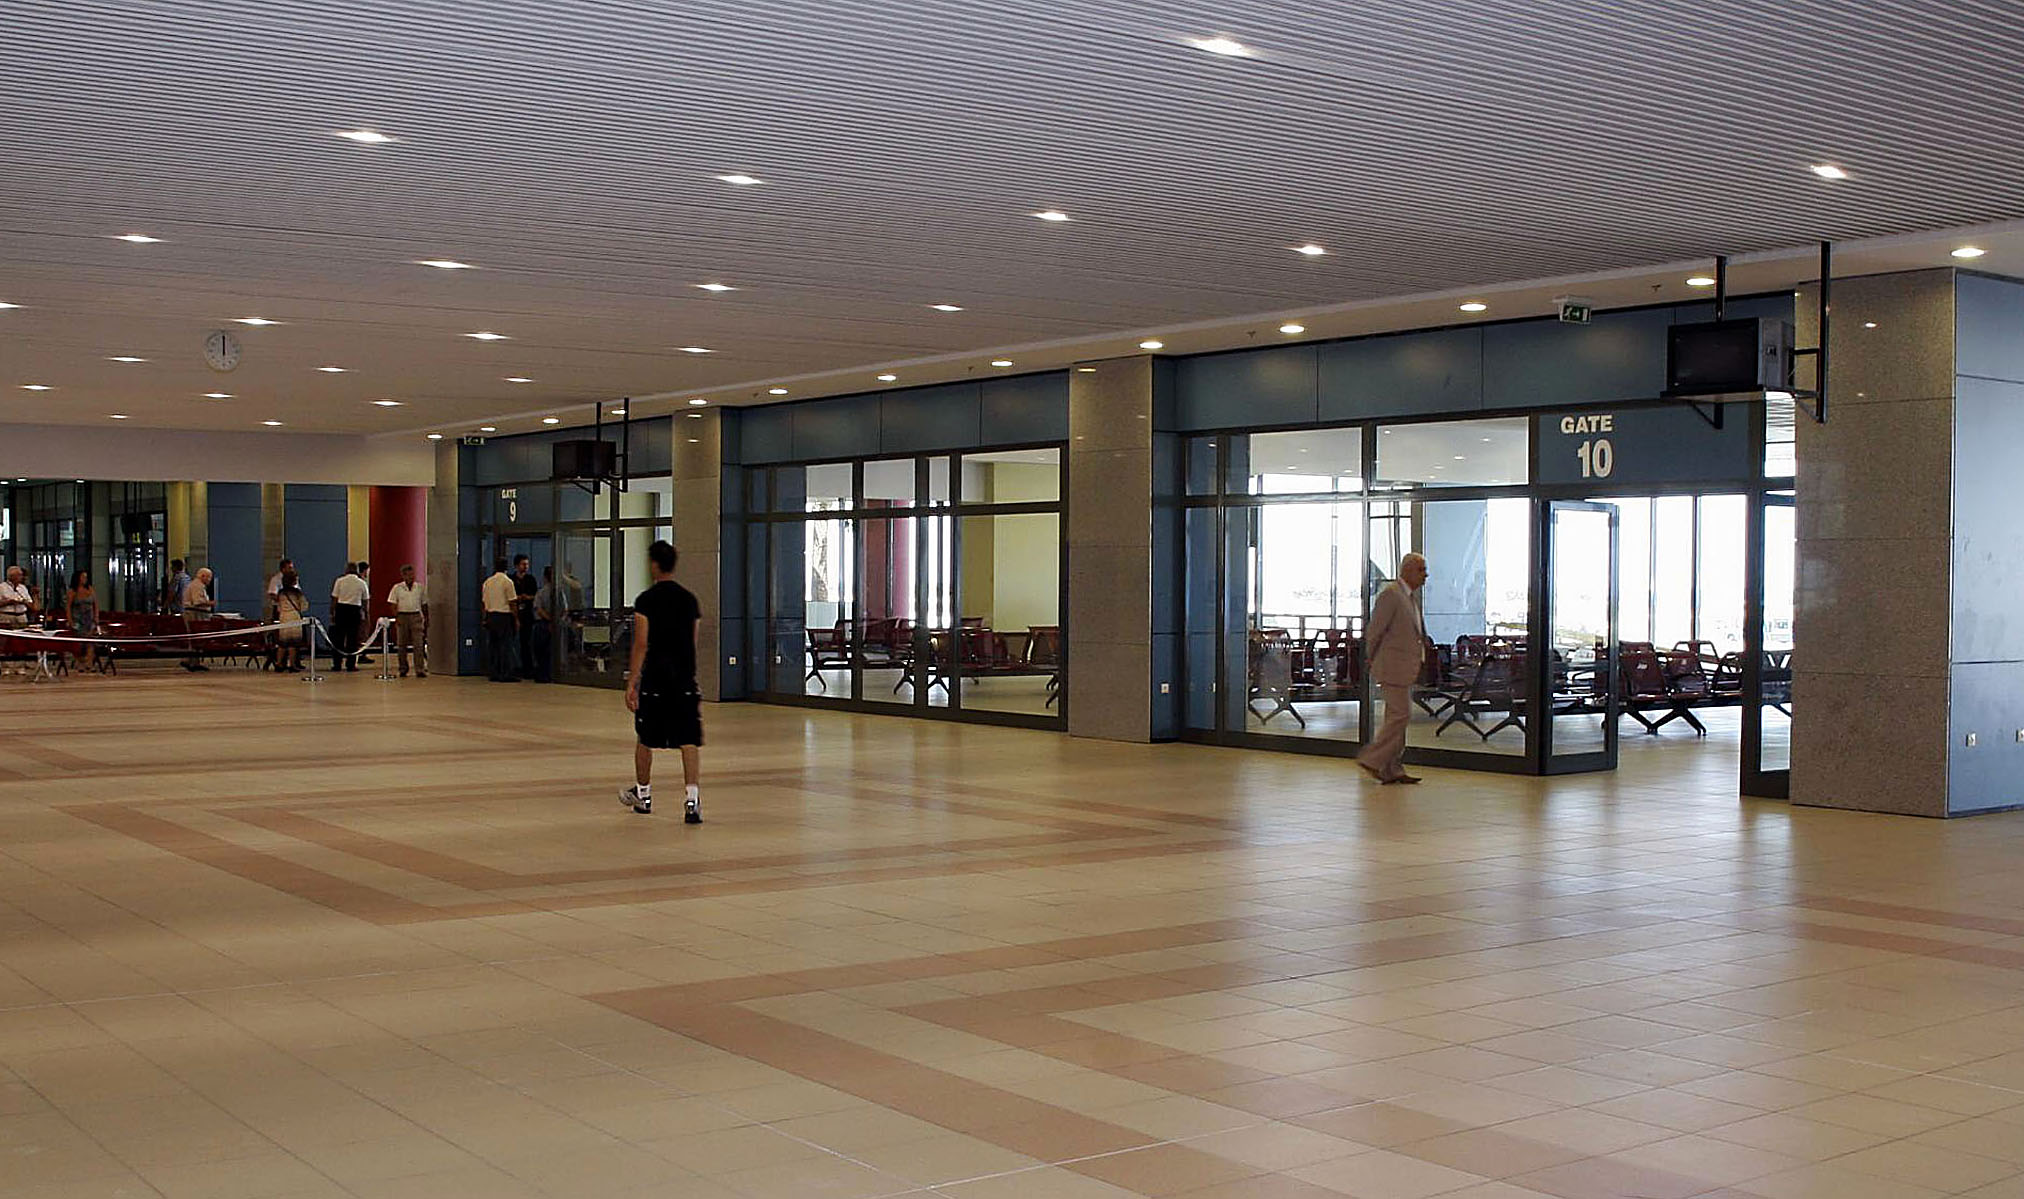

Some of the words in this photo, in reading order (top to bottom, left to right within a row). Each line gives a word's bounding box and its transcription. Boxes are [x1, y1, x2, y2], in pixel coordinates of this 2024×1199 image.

[1560, 414, 1613, 434] GATE
[1577, 439, 1613, 478] 10
[501, 488, 517, 499] GATE
[509, 501, 517, 522] 9
